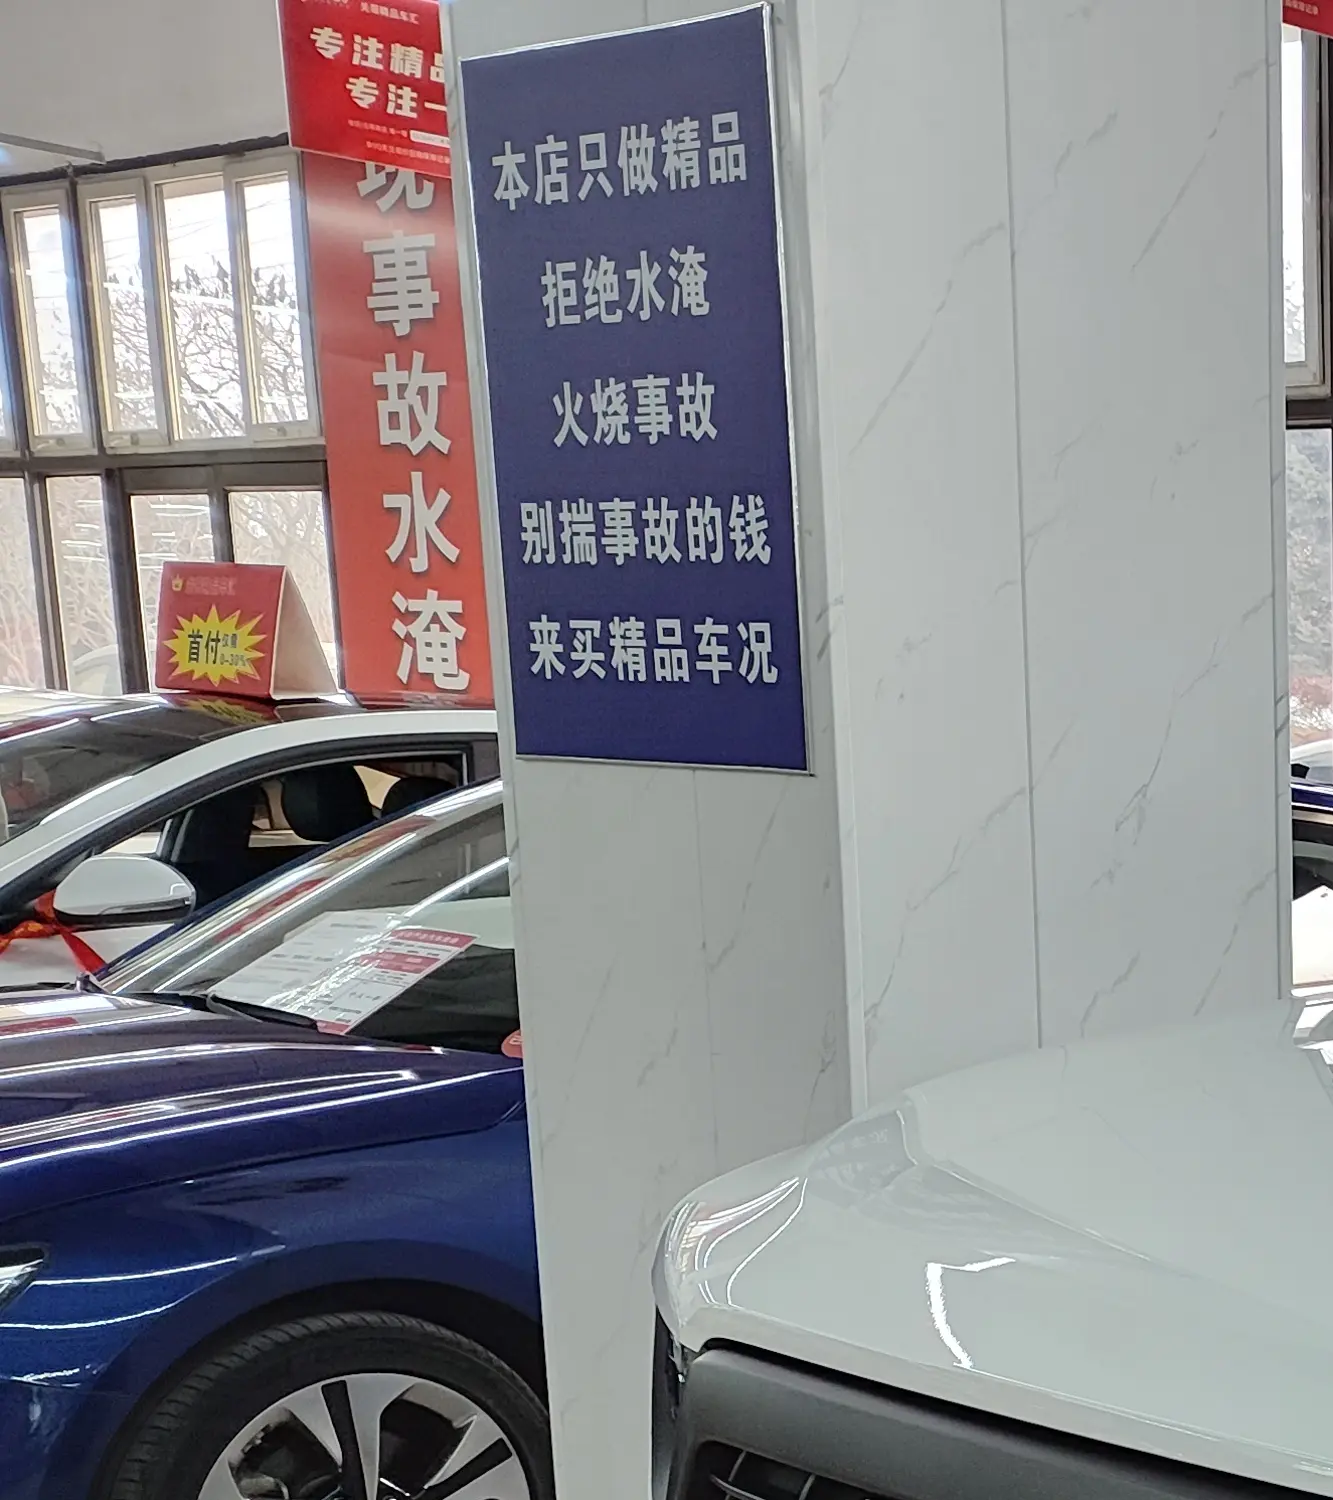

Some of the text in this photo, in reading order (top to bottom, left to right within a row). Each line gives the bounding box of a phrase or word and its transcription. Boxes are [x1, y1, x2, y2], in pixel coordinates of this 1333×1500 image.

[491, 110, 748, 211] 本店只做精品
[541, 246, 711, 329] 拒绝水淹
[551, 372, 718, 448] 火烧事故
[520, 494, 772, 567] 别揣事故的钱
[188, 628, 221, 665] 首付
[528, 614, 779, 687] 来买精品车况
